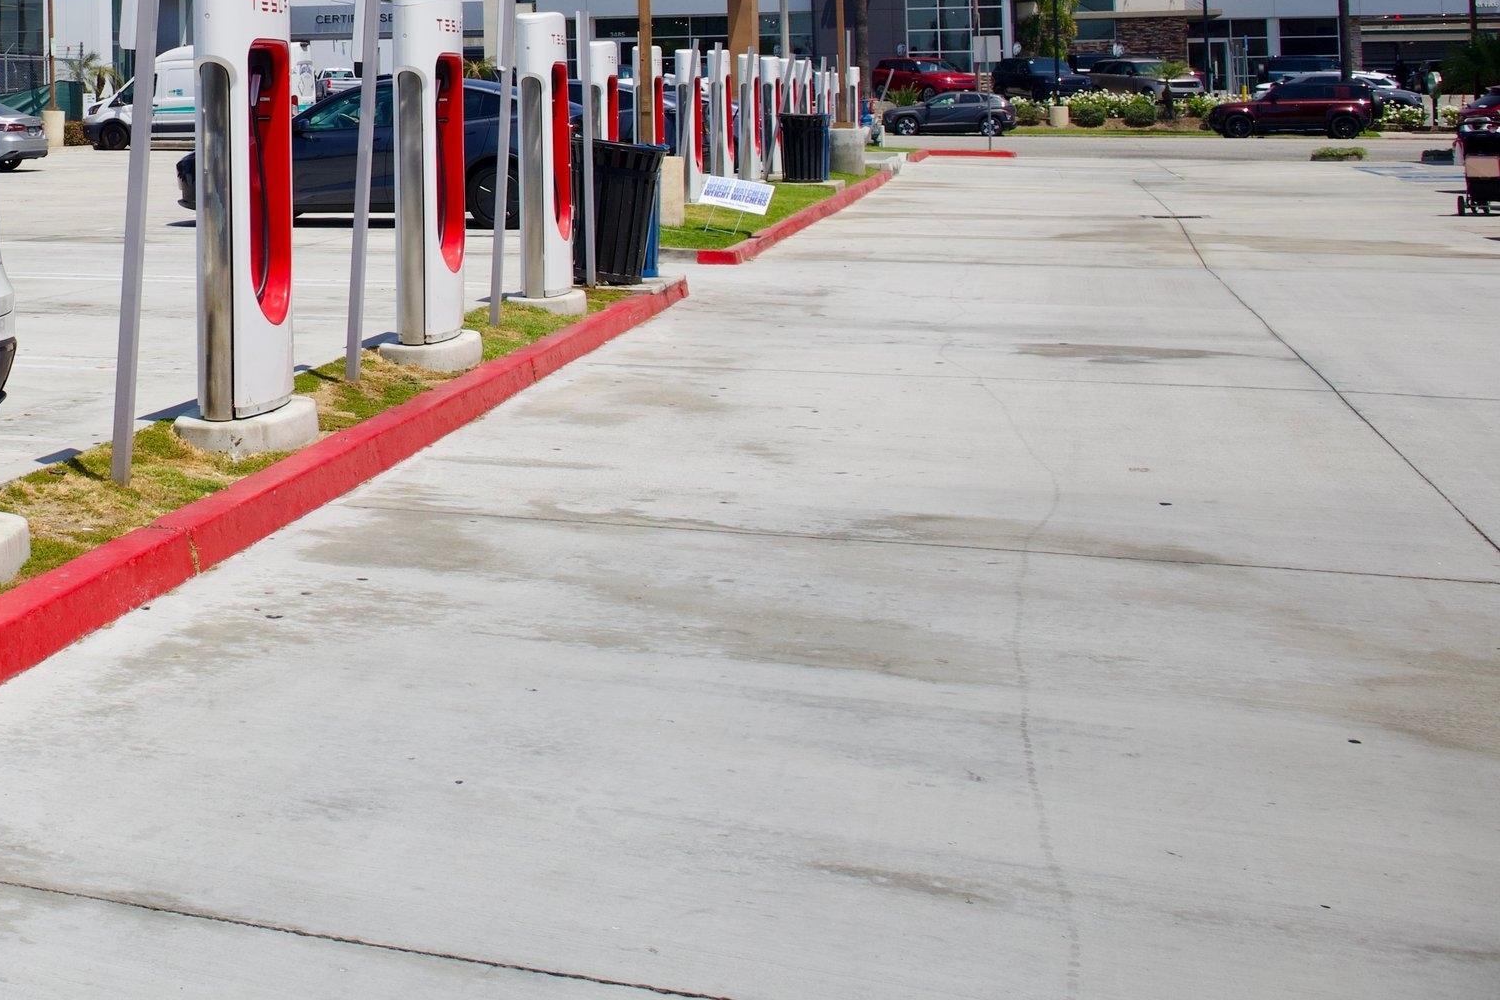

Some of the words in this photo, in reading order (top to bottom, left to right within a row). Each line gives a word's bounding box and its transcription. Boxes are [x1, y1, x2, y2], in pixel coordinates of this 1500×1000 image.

[316, 14, 355, 24] CERTI
[704, 189, 730, 200] WEIGHT
[730, 192, 768, 207] WATCHERS
